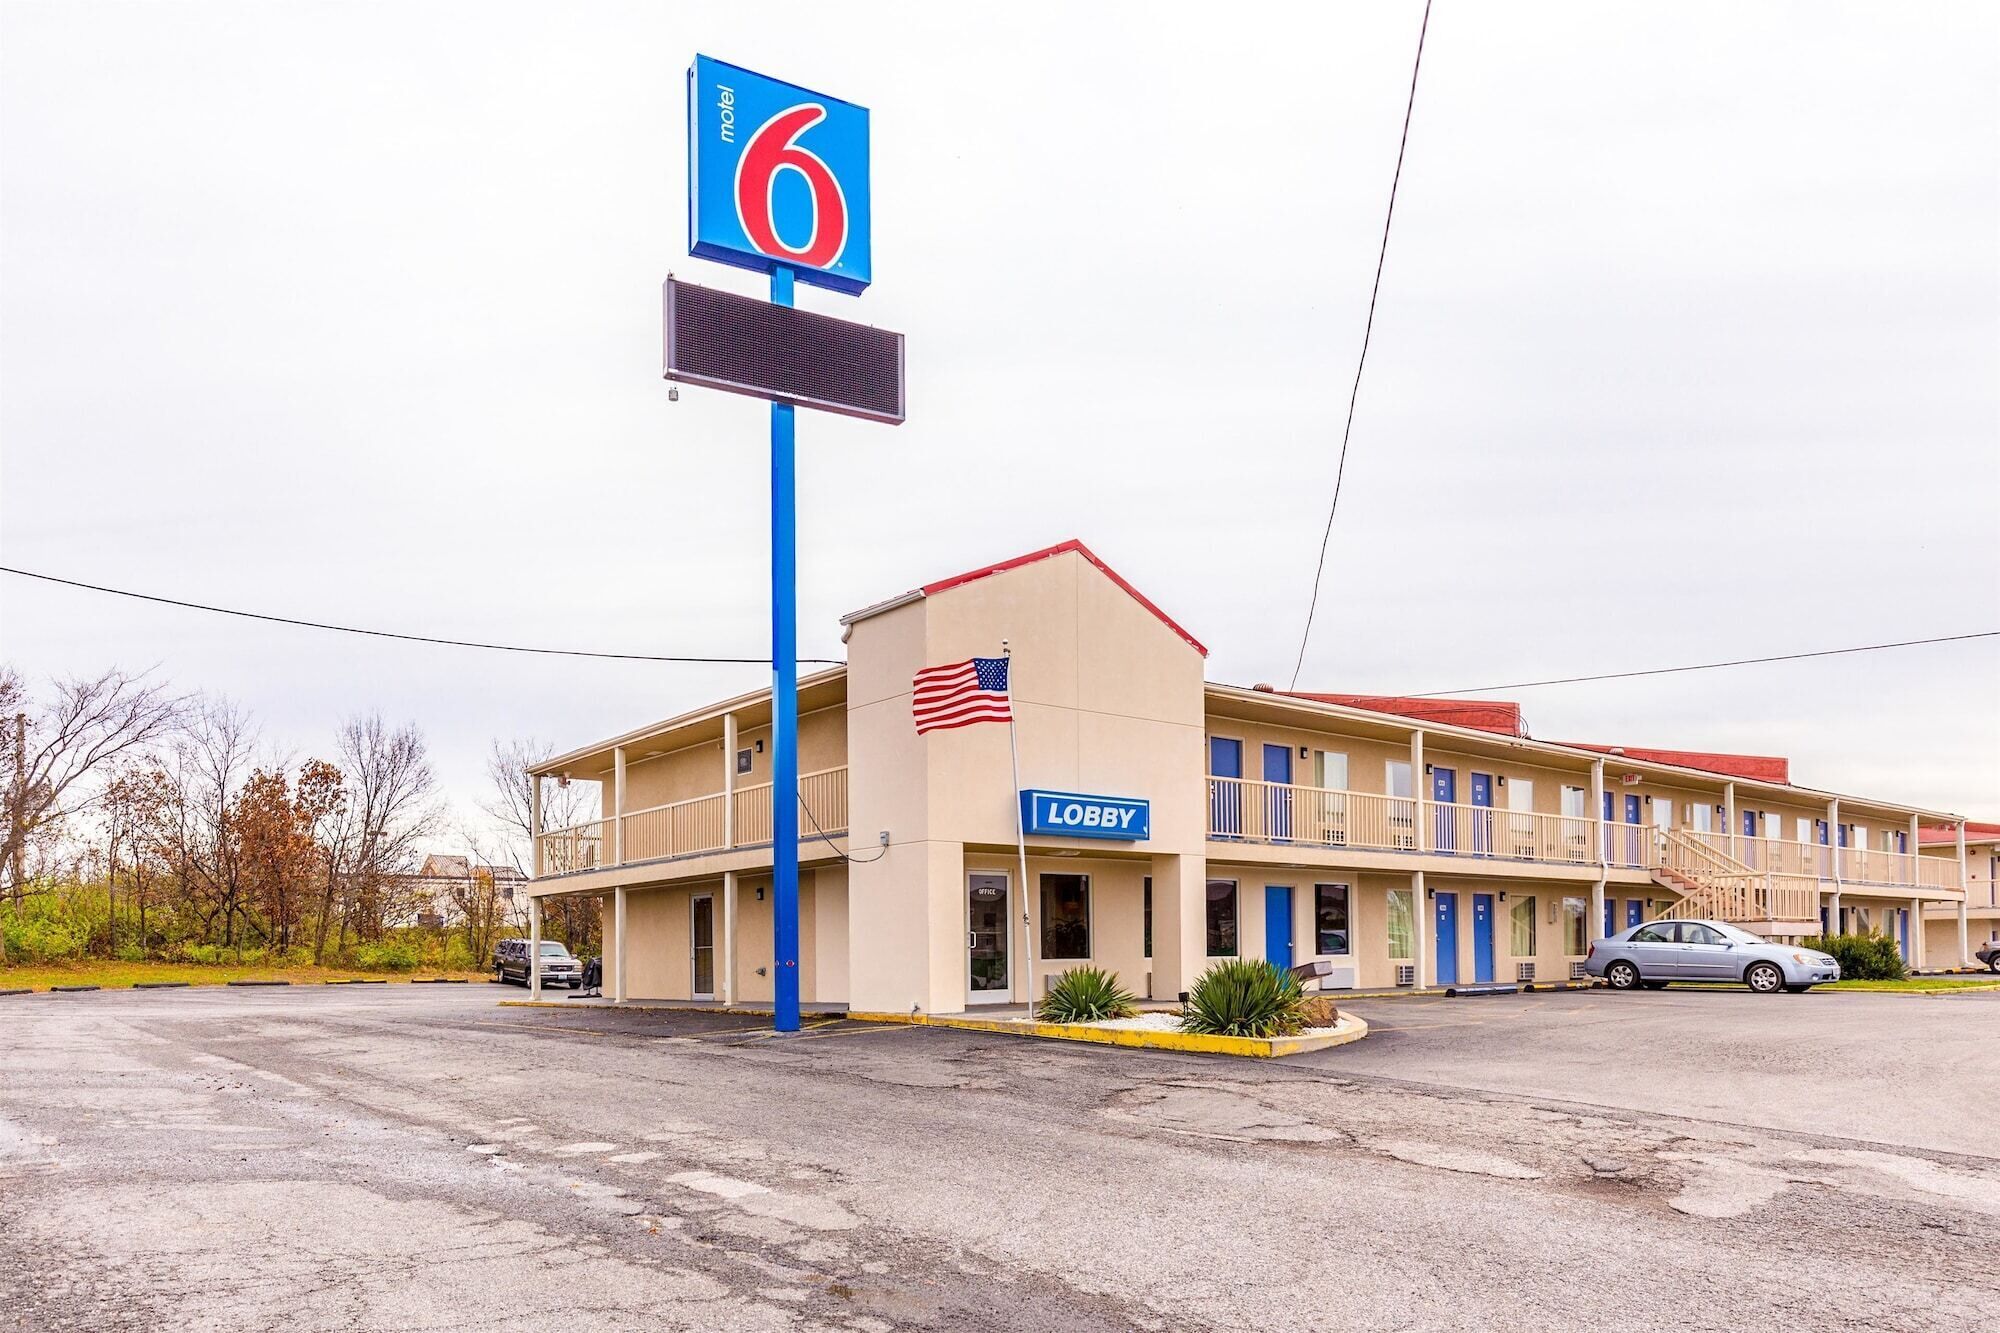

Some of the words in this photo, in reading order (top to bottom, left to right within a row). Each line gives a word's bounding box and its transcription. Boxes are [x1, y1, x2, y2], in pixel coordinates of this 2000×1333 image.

[717, 84, 734, 143] motel
[734, 103, 848, 270] 6
[1048, 803, 1136, 829] LOBBY
